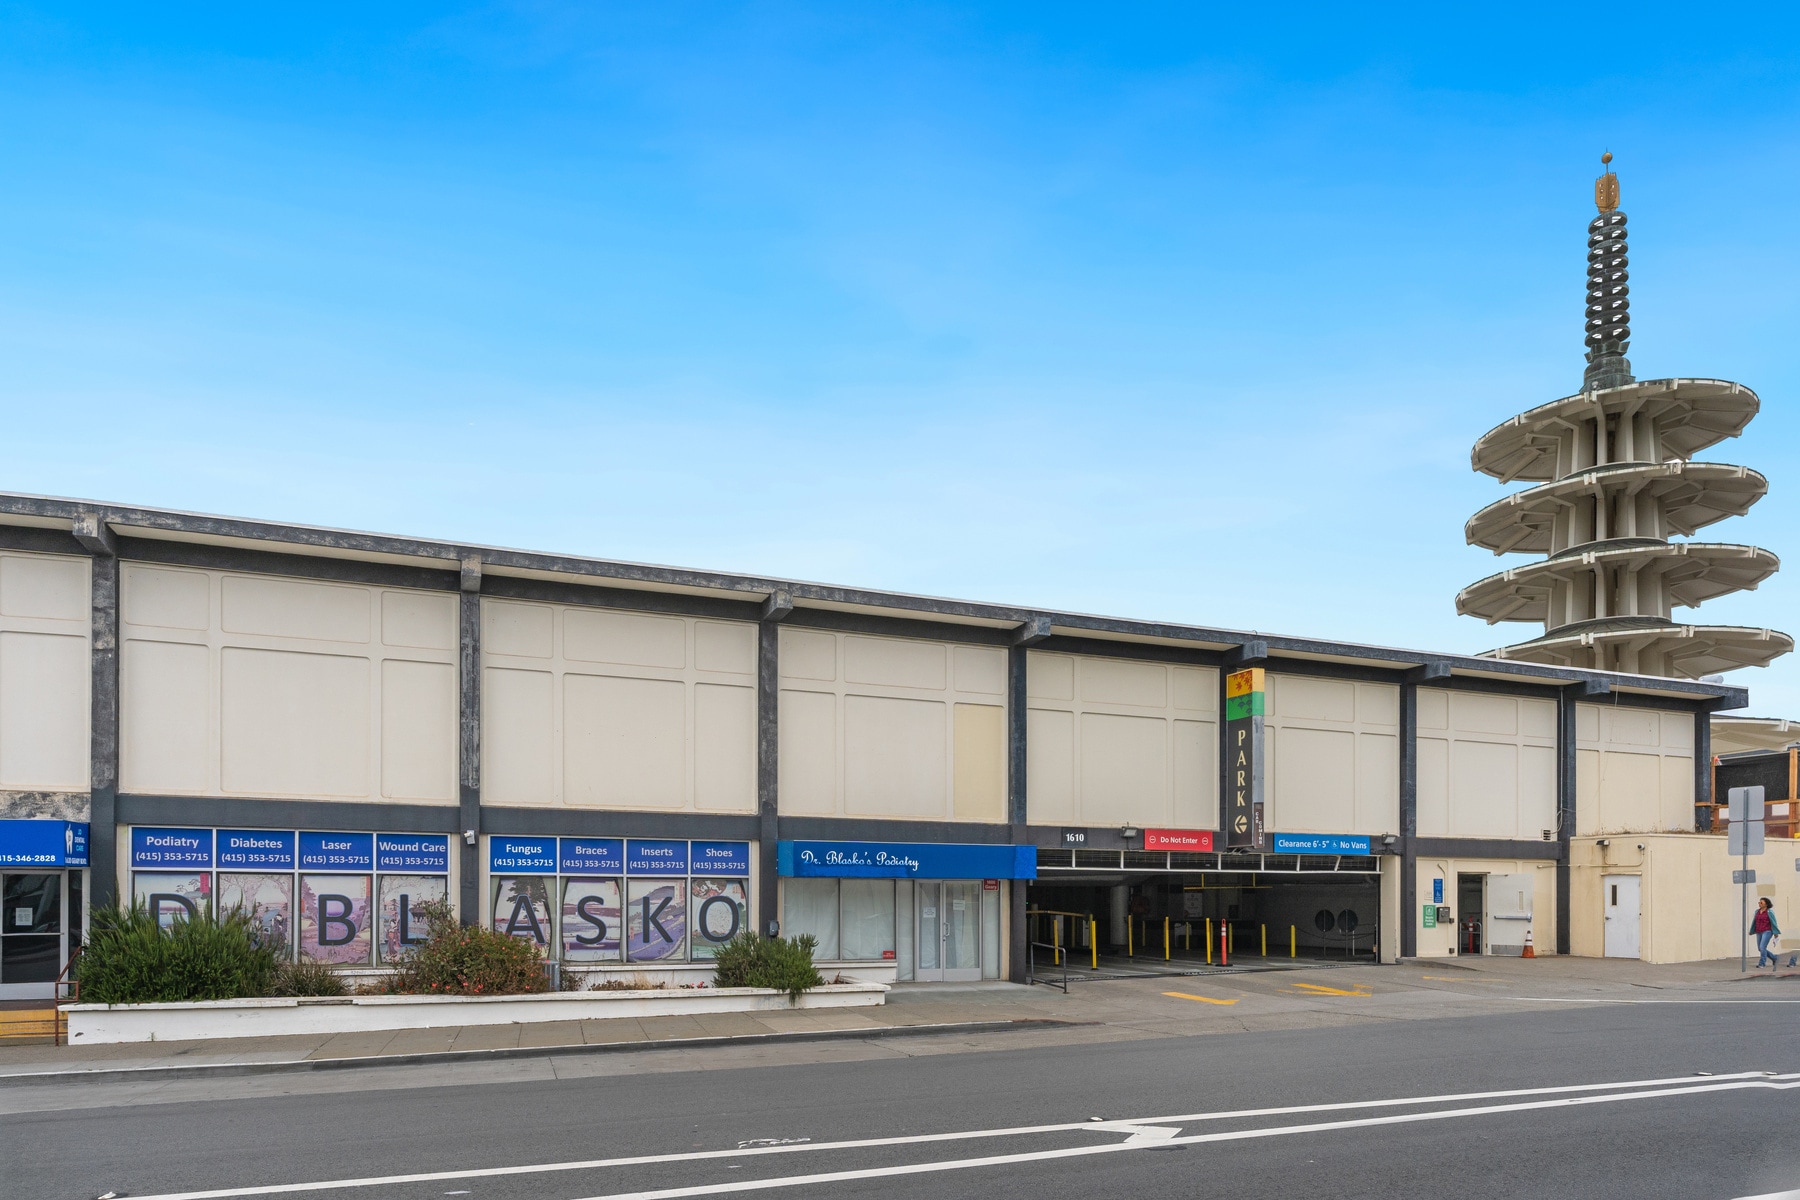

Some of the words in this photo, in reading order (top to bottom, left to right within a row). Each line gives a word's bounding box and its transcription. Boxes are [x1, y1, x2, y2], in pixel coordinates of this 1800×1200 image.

[1236, 730, 1247, 807] PARK
[146, 836, 199, 849] Podiatry
[1065, 833, 1085, 842] 1610
[1160, 836, 1170, 844] Do
[1170, 836, 1182, 844] Not
[1182, 837, 1199, 845] Enter
[230, 838, 283, 849] Diabetes
[322, 840, 352, 850] Laser
[379, 841, 419, 852] Wound
[421, 842, 446, 853] Care
[1278, 839, 1312, 849] Clearance
[1340, 841, 1350, 849] No
[1351, 841, 1367, 849] Vans
[506, 844, 542, 855] Fungus
[575, 845, 608, 855] Braces
[641, 847, 673, 856] Inserts
[706, 848, 733, 857] Shoes
[136, 851, 162, 862] (415)
[164, 851, 209, 862] 353-5715
[221, 853, 246, 863] (415)
[248, 853, 291, 863] 353-5715
[303, 855, 327, 864] (415)
[328, 856, 370, 865] 353-5715
[380, 857, 403, 866] (415)
[405, 857, 444, 866] 353-5715
[801, 850, 821, 865] Dr.
[825, 850, 872, 865] Blasko's
[876, 851, 919, 871] Podiatry
[494, 858, 515, 867] (415)
[517, 858, 554, 867] 353-5715
[562, 859, 583, 868] (415)
[584, 860, 620, 868] 353-5715
[629, 860, 649, 869] (415)
[650, 861, 685, 869] 353-5715
[693, 861, 712, 870] (415)
[713, 862, 746, 870] 353-5715
